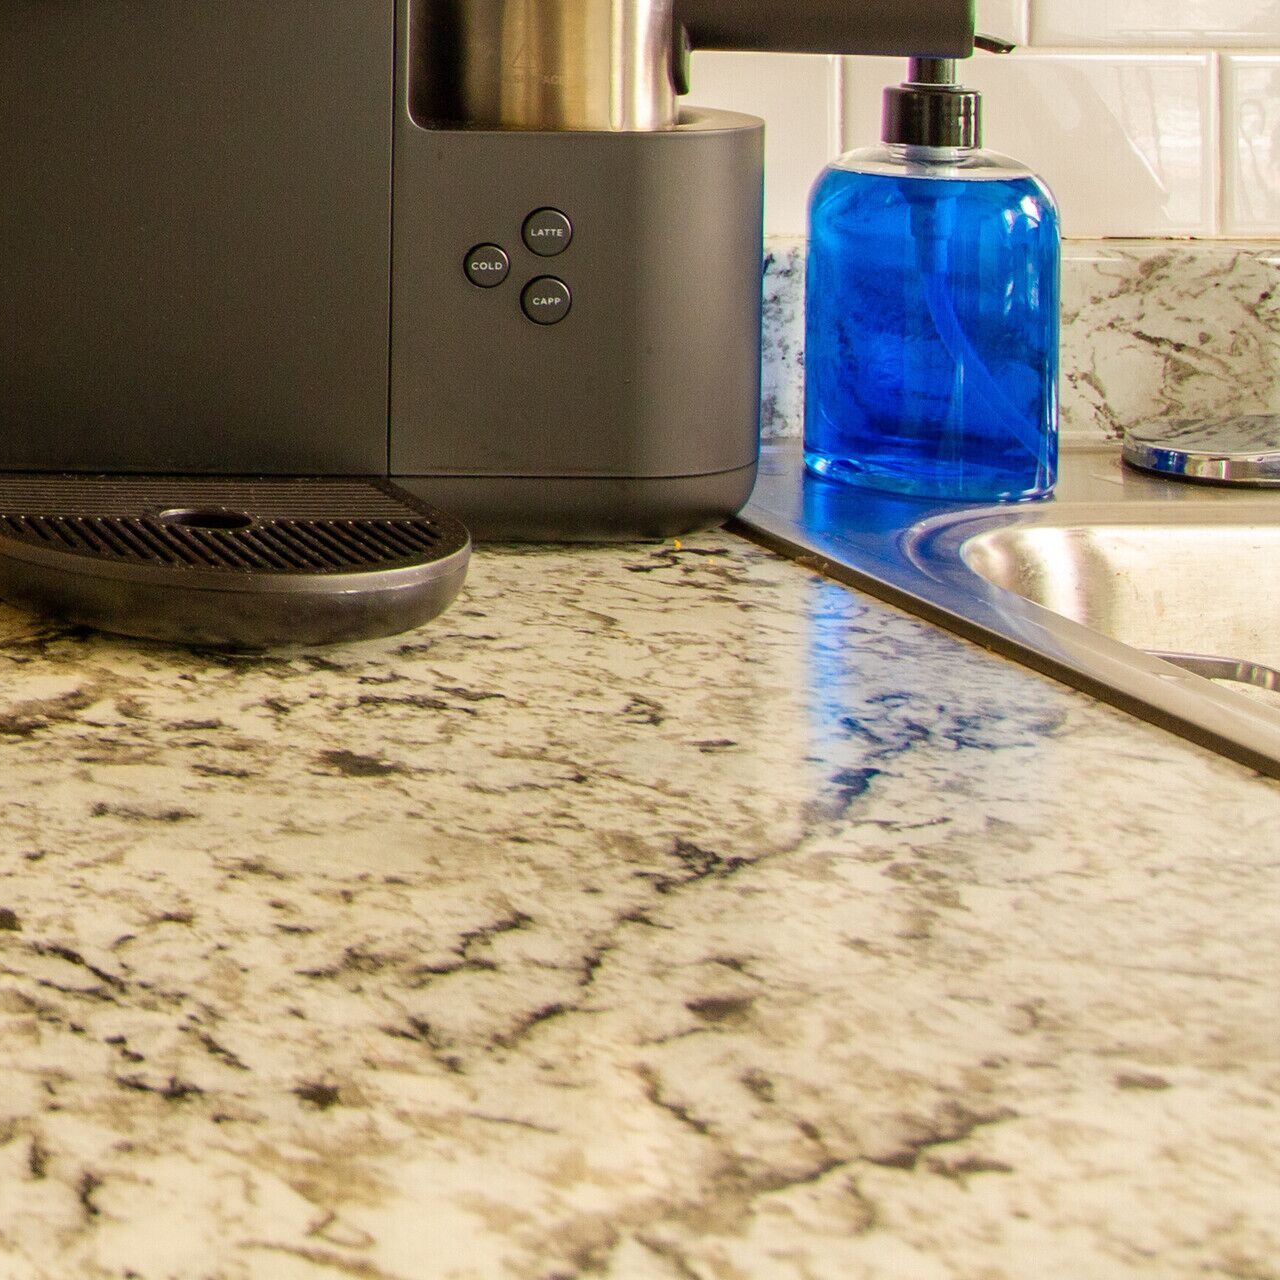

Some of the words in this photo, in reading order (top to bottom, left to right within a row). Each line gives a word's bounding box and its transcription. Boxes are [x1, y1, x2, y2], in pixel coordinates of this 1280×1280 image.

[531, 228, 564, 237] LATTE
[471, 262, 503, 270] COLD
[532, 297, 561, 305] CAPP
